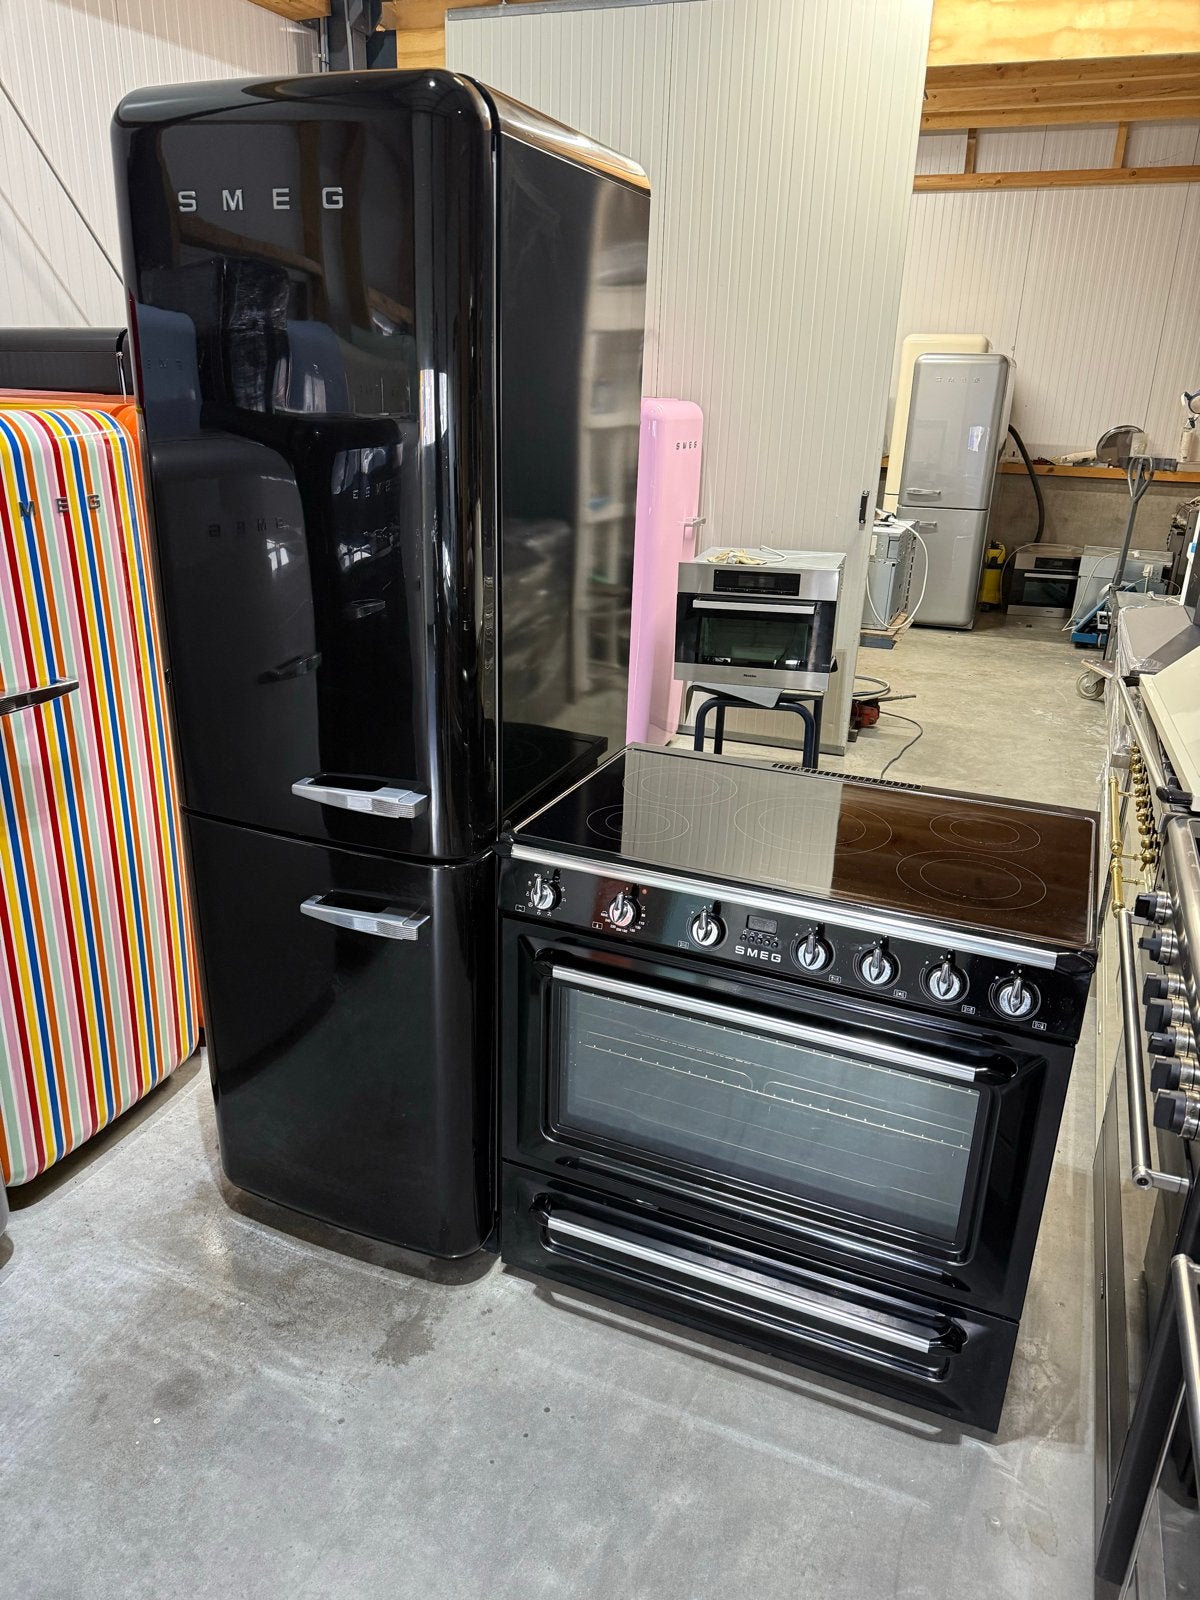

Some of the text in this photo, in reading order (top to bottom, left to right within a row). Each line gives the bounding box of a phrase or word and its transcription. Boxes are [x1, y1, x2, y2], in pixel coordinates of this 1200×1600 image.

[177, 186, 344, 213] SMEG
[18, 494, 101, 518] MEG
[734, 944, 782, 963] SMEG
